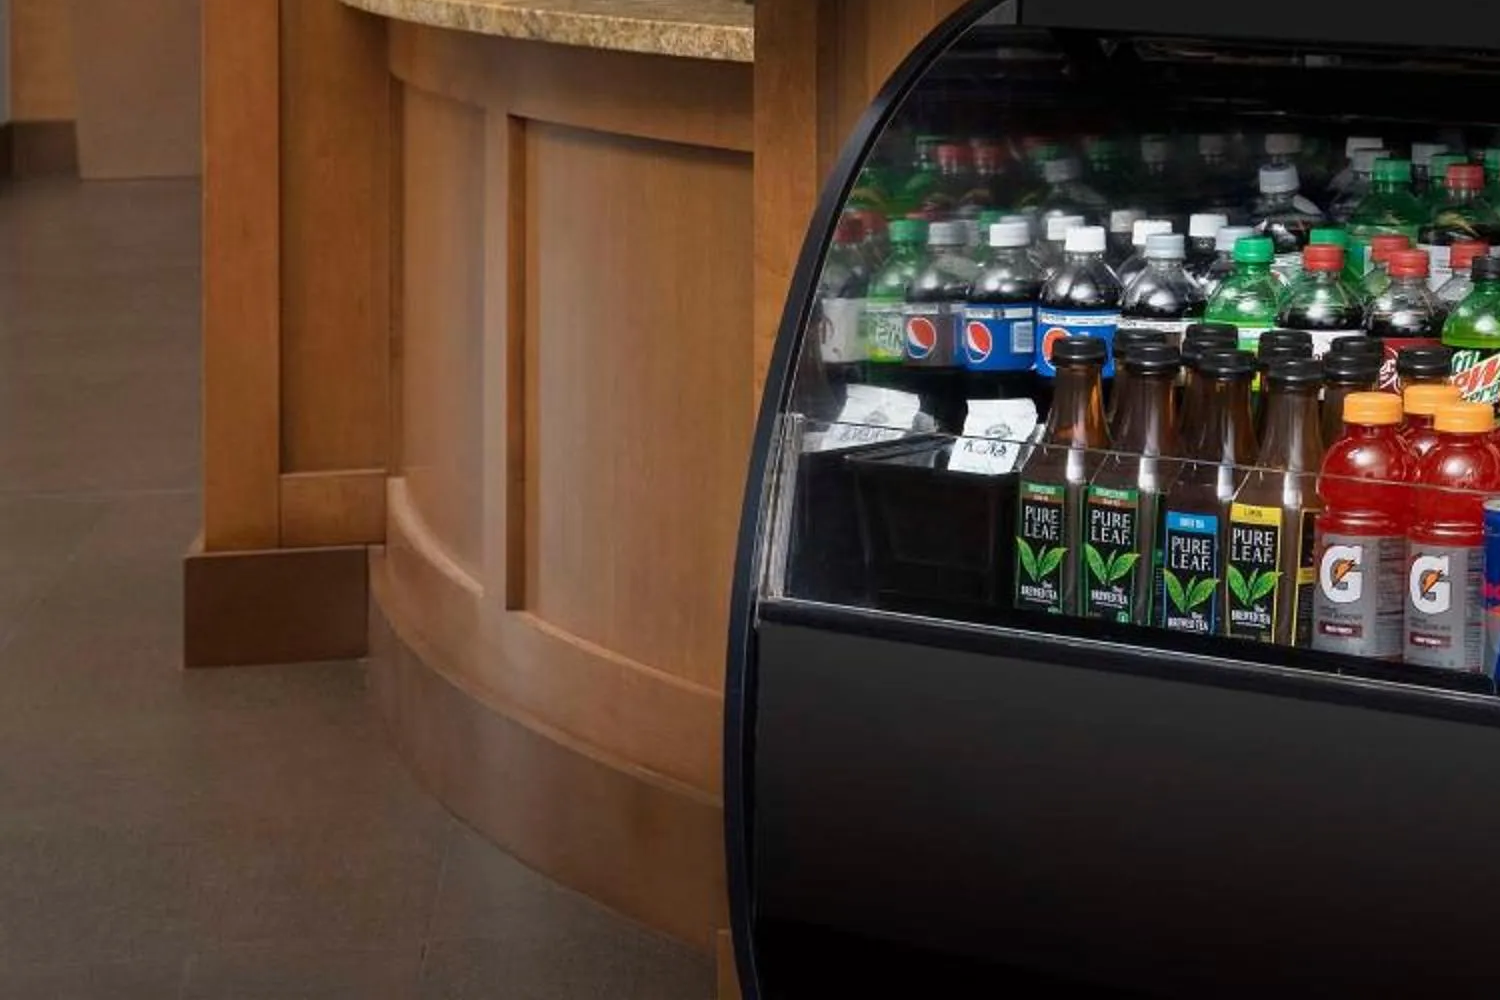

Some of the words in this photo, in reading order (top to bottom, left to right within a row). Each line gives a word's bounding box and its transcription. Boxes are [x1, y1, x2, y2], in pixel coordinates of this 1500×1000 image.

[1025, 505, 1060, 525] PURE
[1091, 509, 1131, 529] PURE
[1171, 535, 1211, 555] PURE
[1232, 527, 1274, 547] PURE
[1320, 545, 1362, 603] G
[1410, 555, 1449, 614] G
